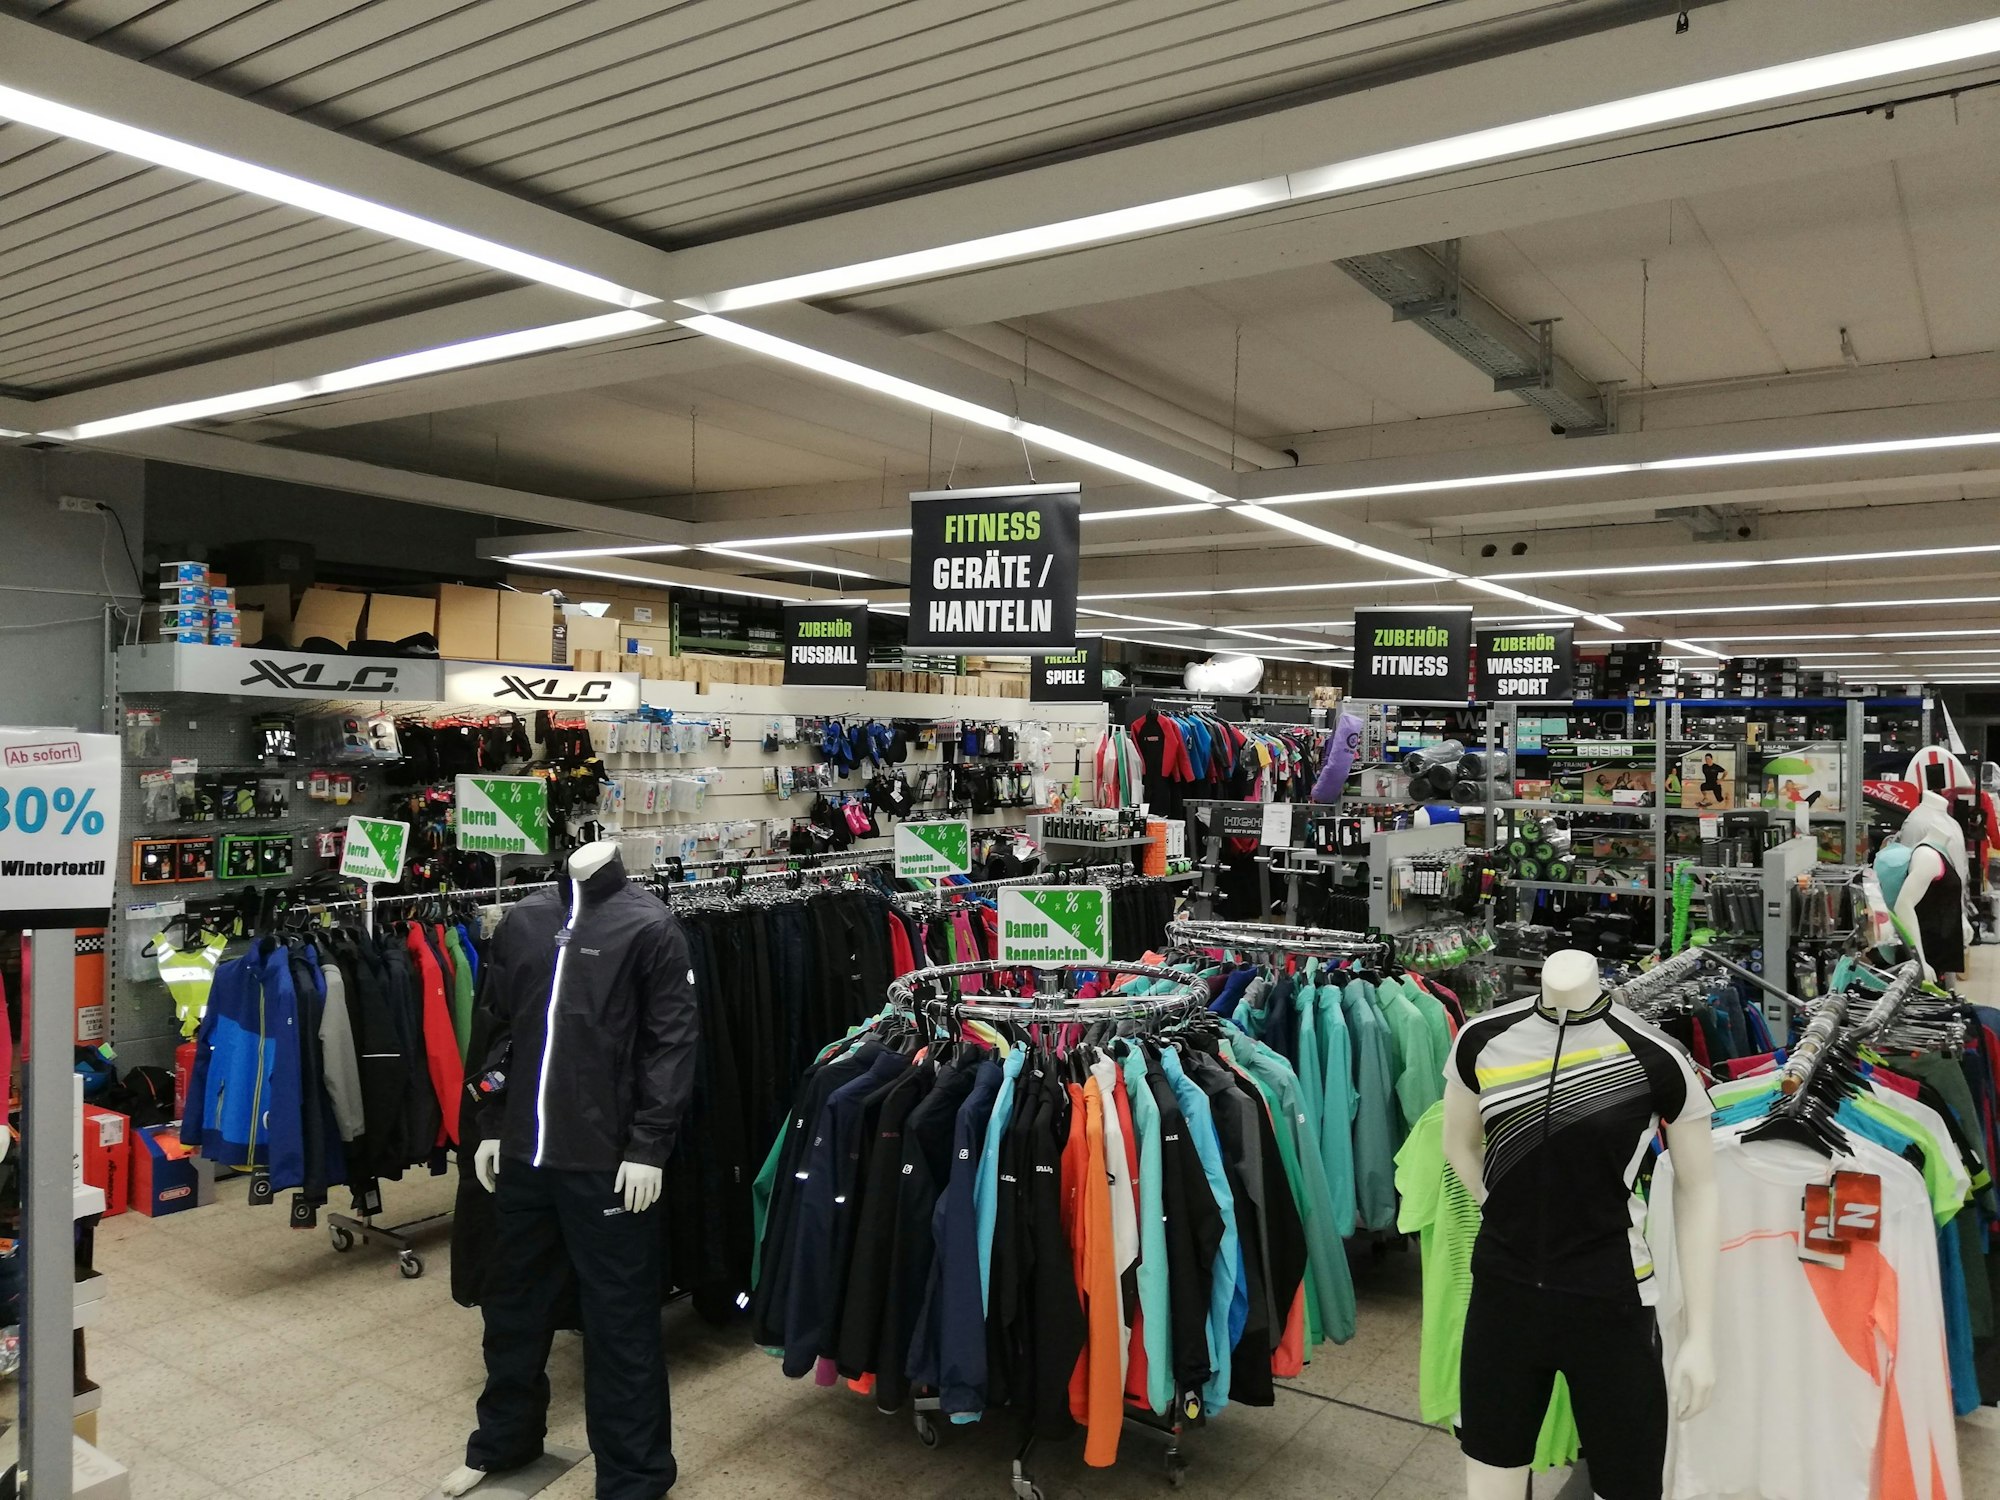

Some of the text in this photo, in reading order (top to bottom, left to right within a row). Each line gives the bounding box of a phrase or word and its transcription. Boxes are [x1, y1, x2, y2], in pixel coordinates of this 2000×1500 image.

[945, 511, 1041, 543] FITNESS
[933, 550, 1031, 590] GERÄTE
[929, 599, 1052, 632] HANTELN
[798, 618, 852, 638] ZUBEHÖR
[1374, 626, 1449, 647] ZUBEHÖR
[1493, 633, 1555, 652] ZUBEHÖR
[791, 645, 858, 665] FUSSBALL
[1371, 655, 1449, 676] FITNESS
[1487, 656, 1560, 674] WASSER-
[240, 659, 398, 693] XLC
[1046, 669, 1085, 685] SPIELE
[493, 675, 612, 702] XLC
[1498, 678, 1549, 695] SPORT
[10, 745, 78, 764] Ab sofort!
[462, 807, 497, 826] Herren
[1, 860, 105, 876] Wintertextil
[900, 853, 934, 864] egenhosen
[1005, 920, 1049, 938] Damen
